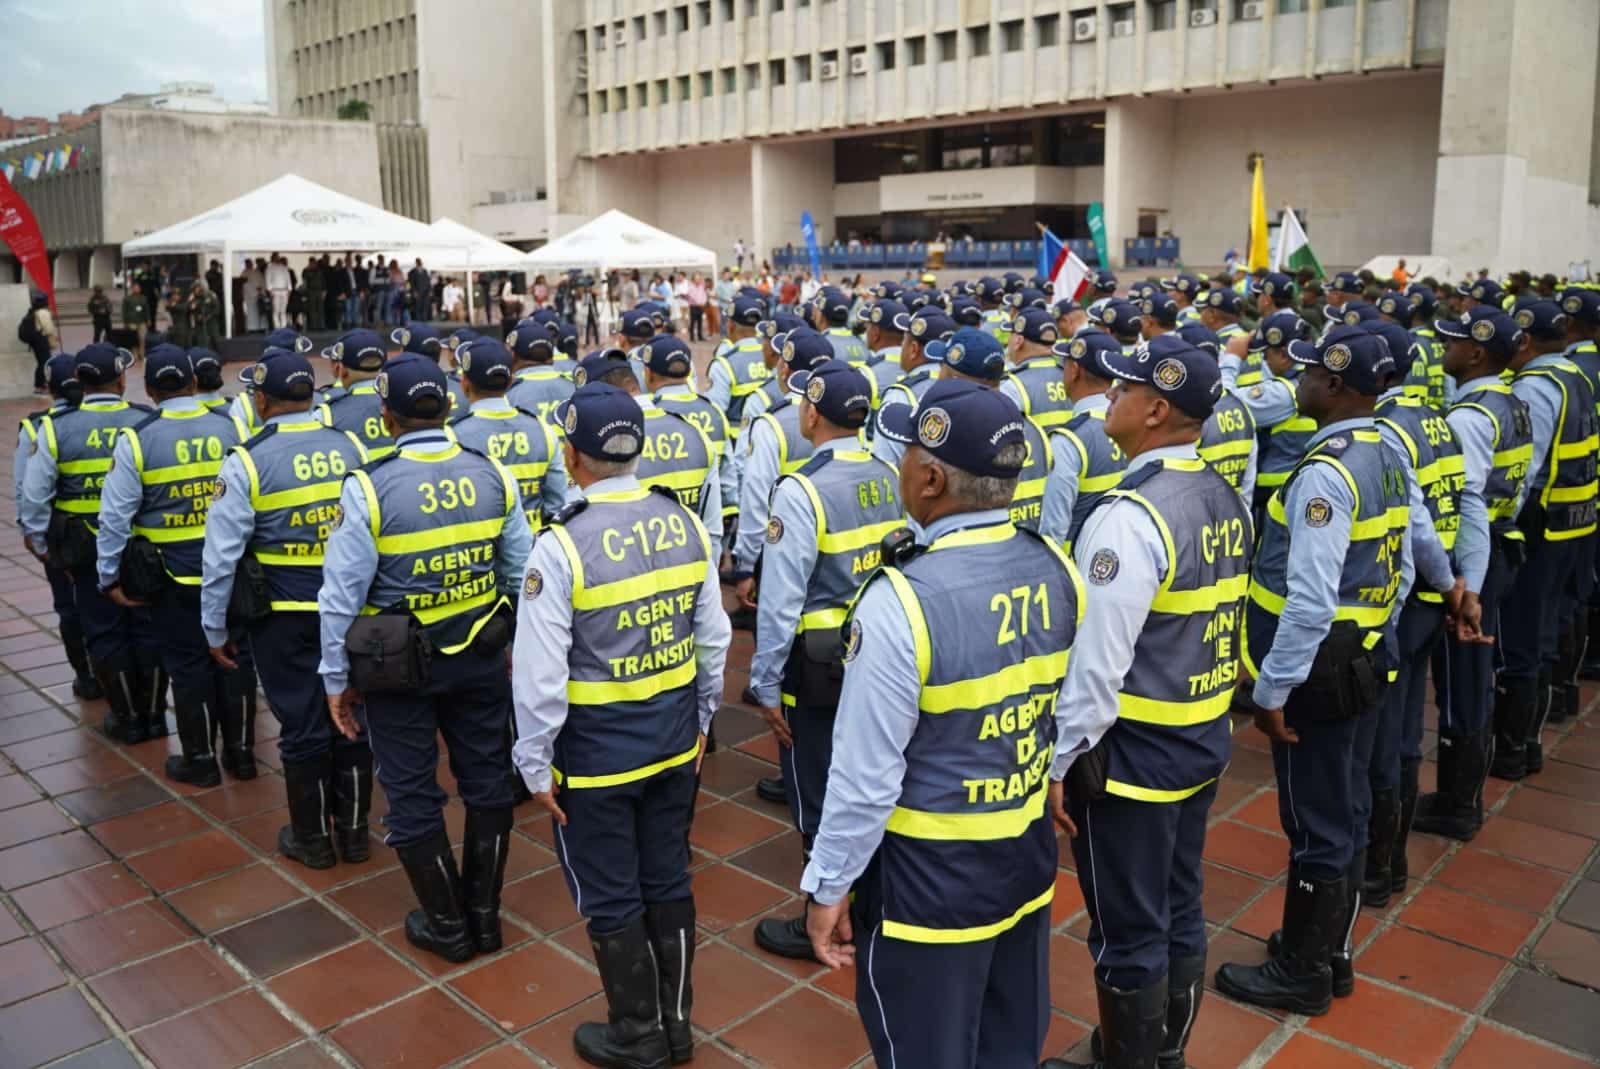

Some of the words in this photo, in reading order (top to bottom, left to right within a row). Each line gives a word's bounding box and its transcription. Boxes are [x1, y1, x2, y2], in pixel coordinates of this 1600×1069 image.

[1046, 382, 1067, 402] 56
[688, 411, 715, 432] 62
[1216, 407, 1246, 433] 063
[86, 427, 118, 450] 47
[176, 436, 223, 465] 670
[487, 431, 531, 460] 678
[641, 431, 689, 463] 462
[292, 449, 347, 481] 666
[170, 479, 216, 499] AGEN
[417, 476, 477, 514] 330
[162, 510, 209, 528] TRAN
[289, 503, 340, 527] AGEN
[1009, 501, 1041, 522] ENTE
[317, 523, 331, 541] D
[602, 513, 688, 562] C-129
[411, 543, 494, 576] AGENTE
[405, 569, 496, 611] TRANSITO
[442, 569, 472, 588] DE
[616, 590, 696, 631] AGENTE
[990, 583, 1051, 646] 271
[650, 620, 675, 648] DE
